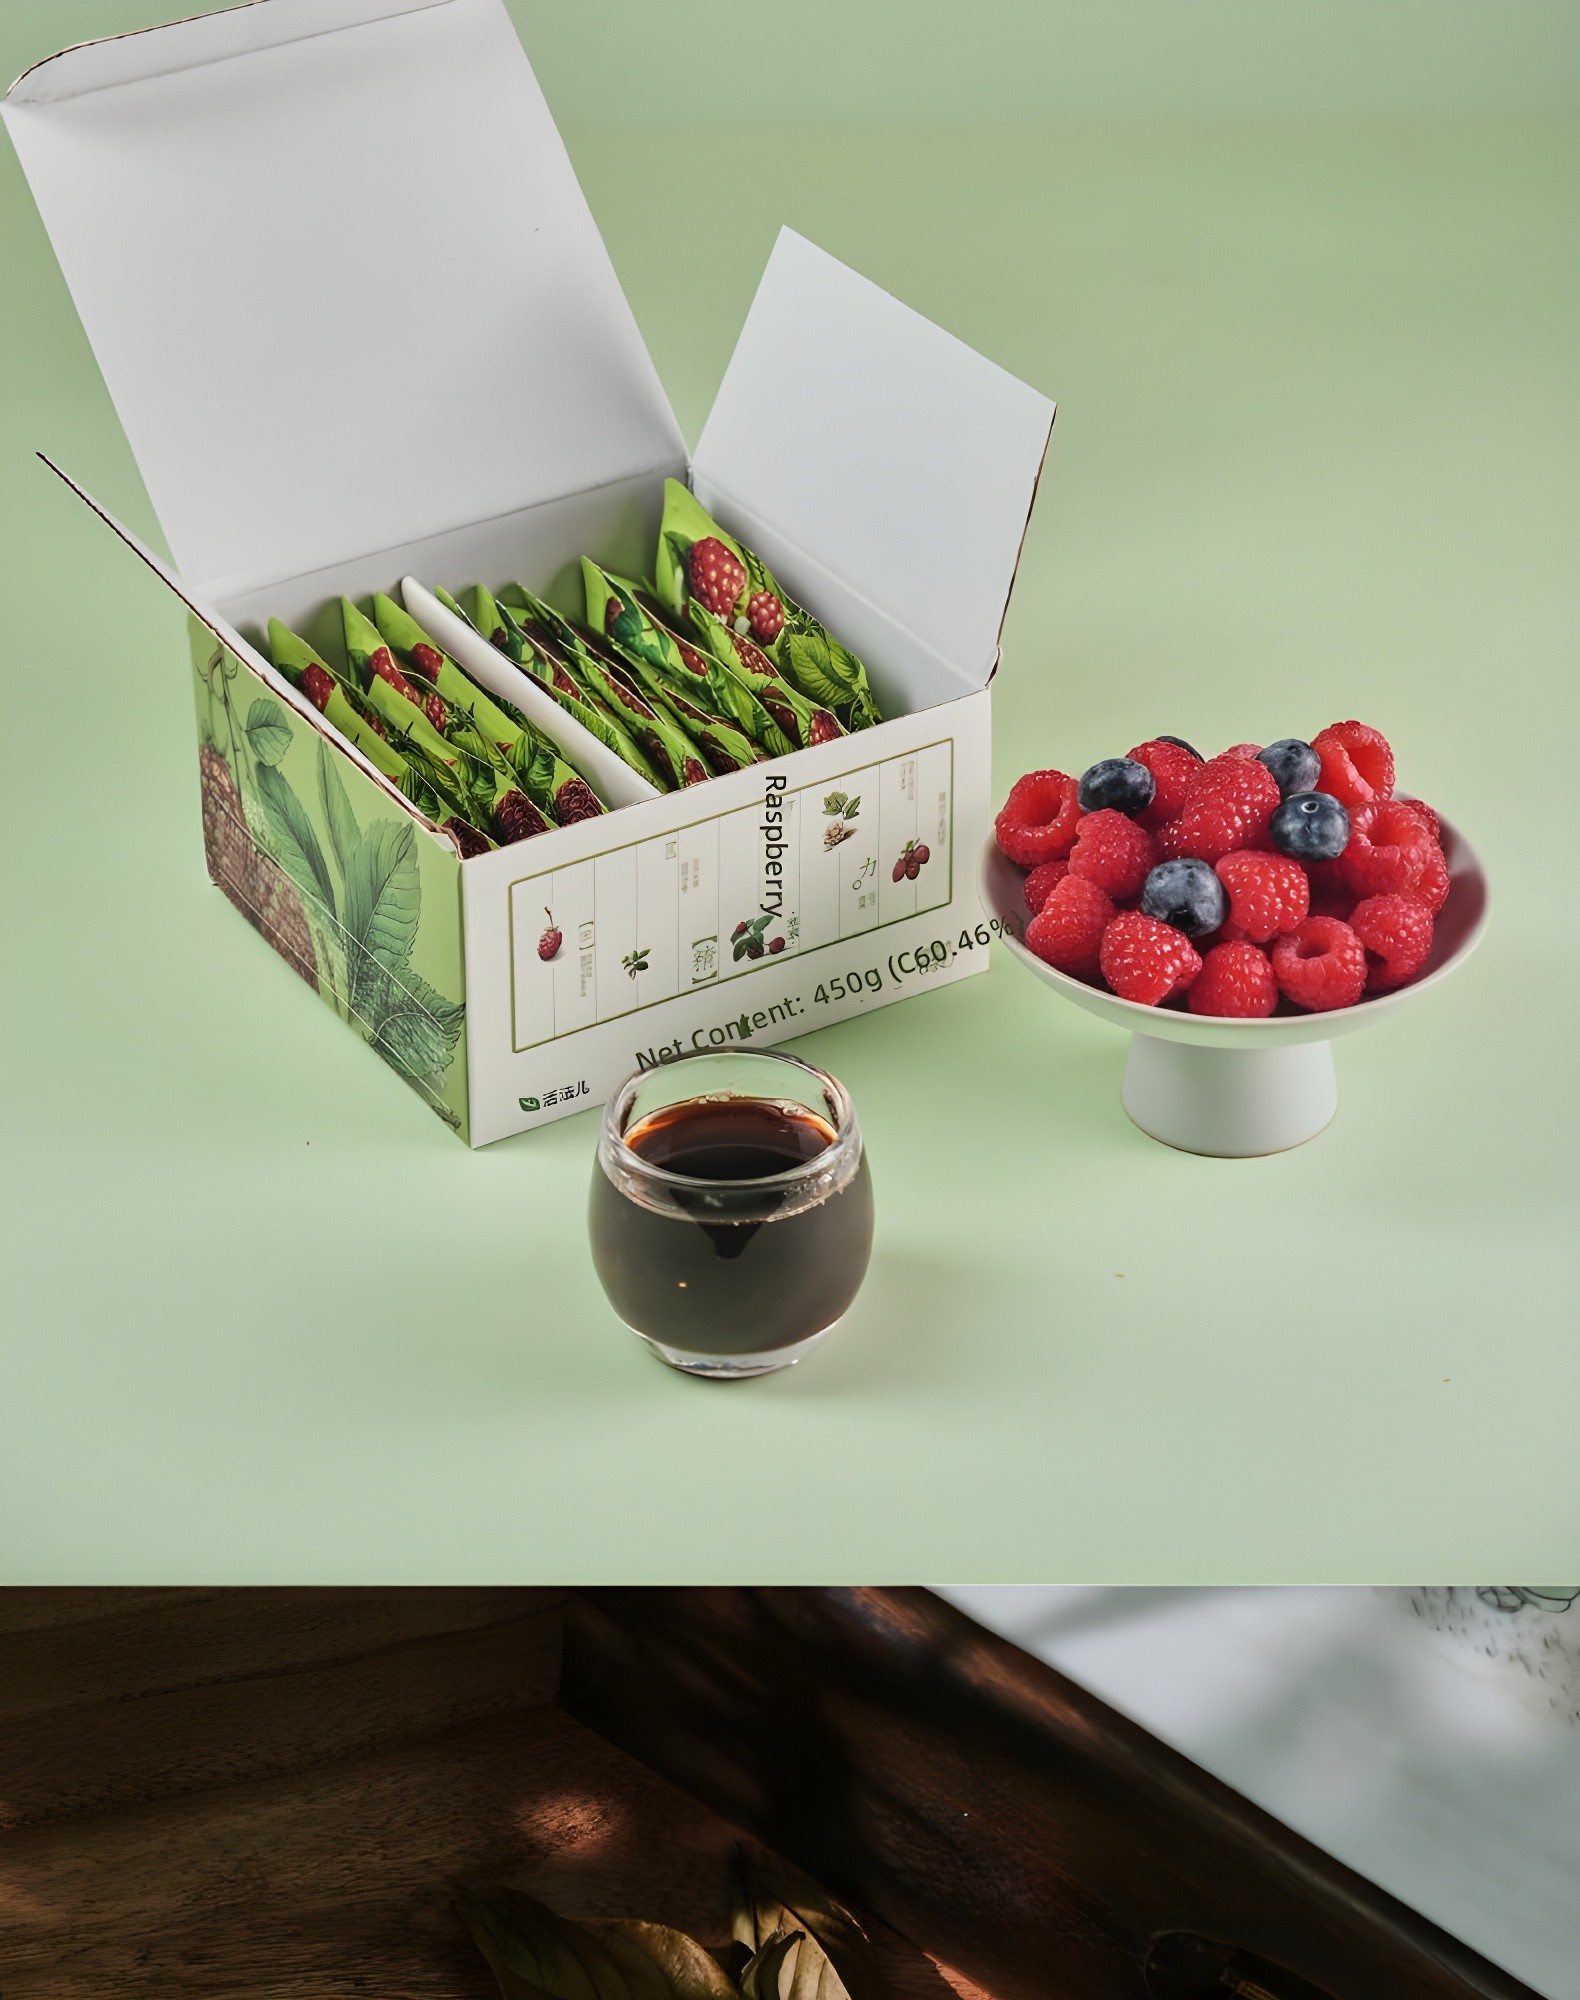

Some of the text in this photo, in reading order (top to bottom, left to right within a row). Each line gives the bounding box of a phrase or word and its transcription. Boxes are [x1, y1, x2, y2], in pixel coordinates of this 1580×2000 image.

[760, 775, 789, 918] Raspberry
[635, 1039, 682, 1072] Net
[814, 968, 883, 1004] 450g
